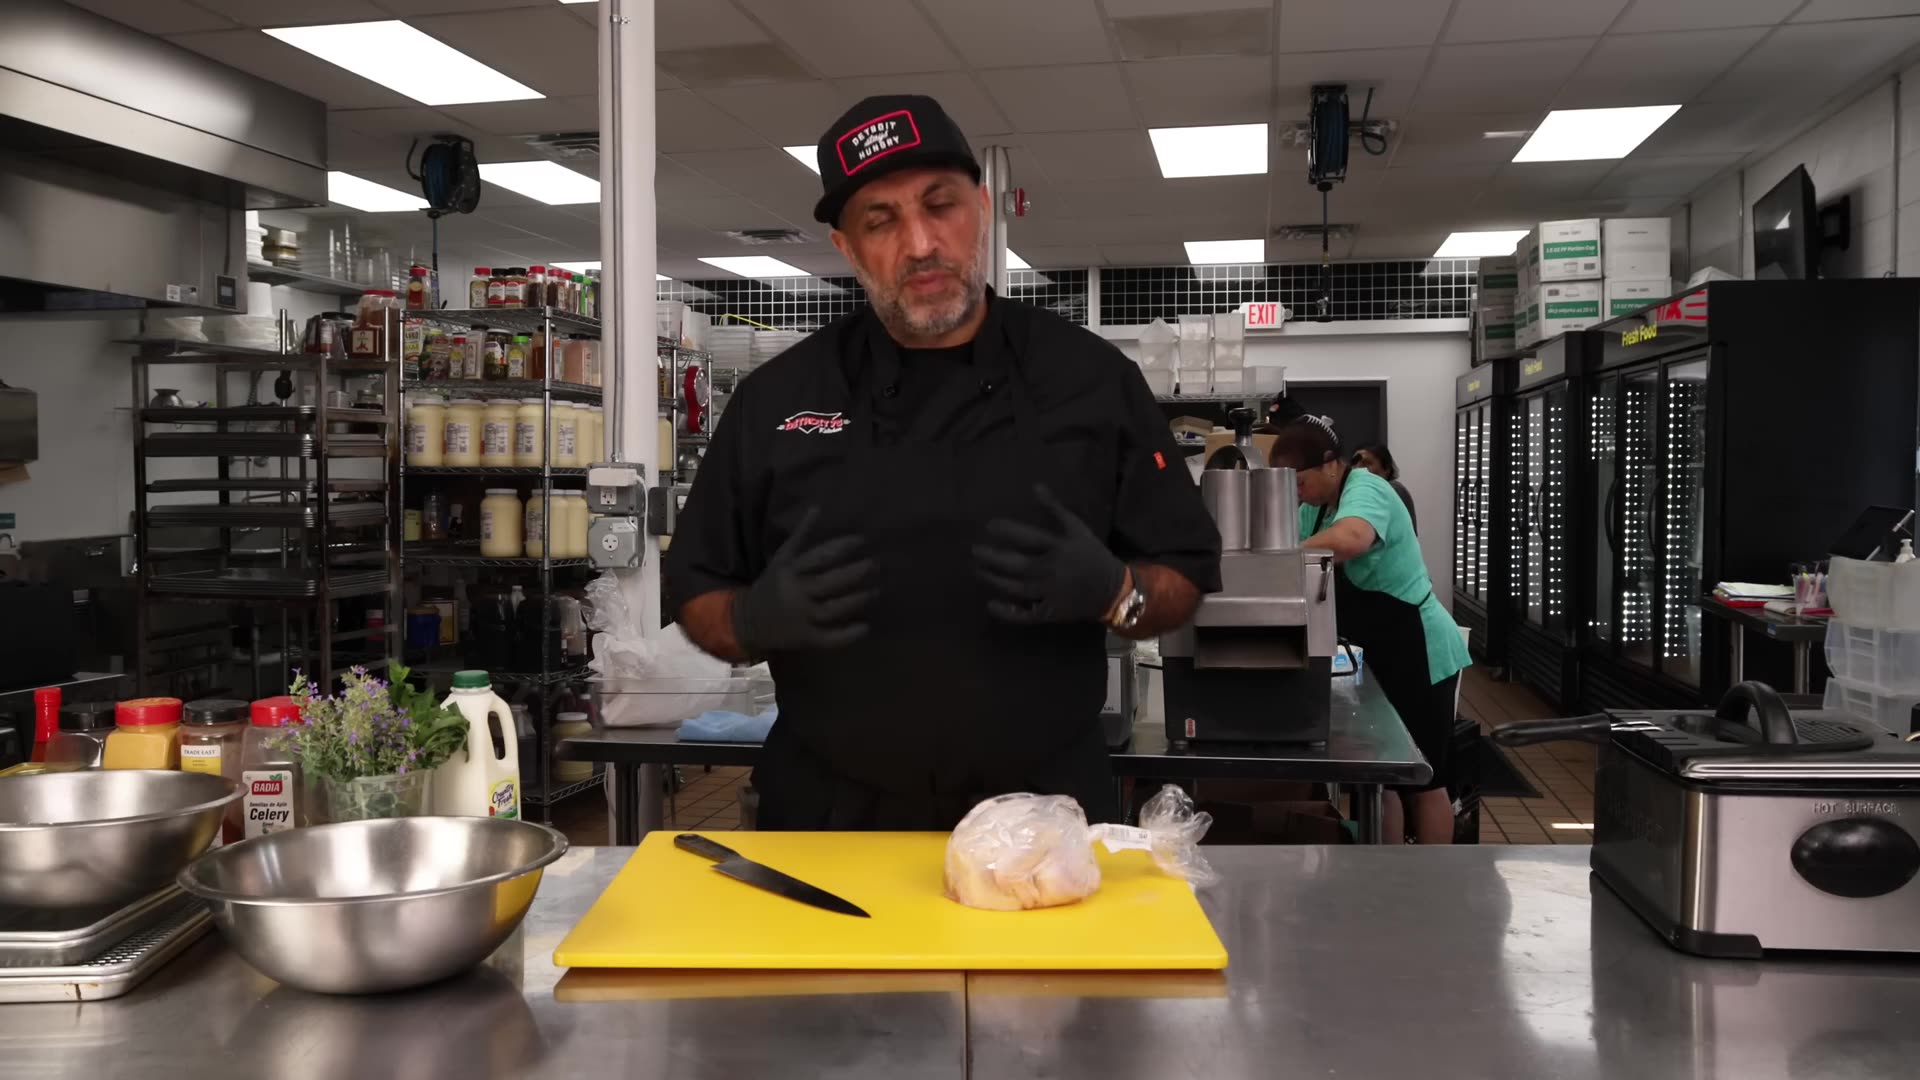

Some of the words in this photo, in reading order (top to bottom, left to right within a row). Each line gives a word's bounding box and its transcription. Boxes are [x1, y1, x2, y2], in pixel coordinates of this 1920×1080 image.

[852, 121, 896, 146] DETROIT
[859, 136, 899, 160] HUNGRY
[1248, 303, 1278, 325] EXIT
[1622, 326, 1639, 347] Fresh
[1640, 320, 1657, 342] Food
[253, 782, 280, 793] BADIA
[249, 808, 289, 823] Celery
[1812, 802, 1837, 814] HOT
[1844, 802, 1897, 814] SURFACE
